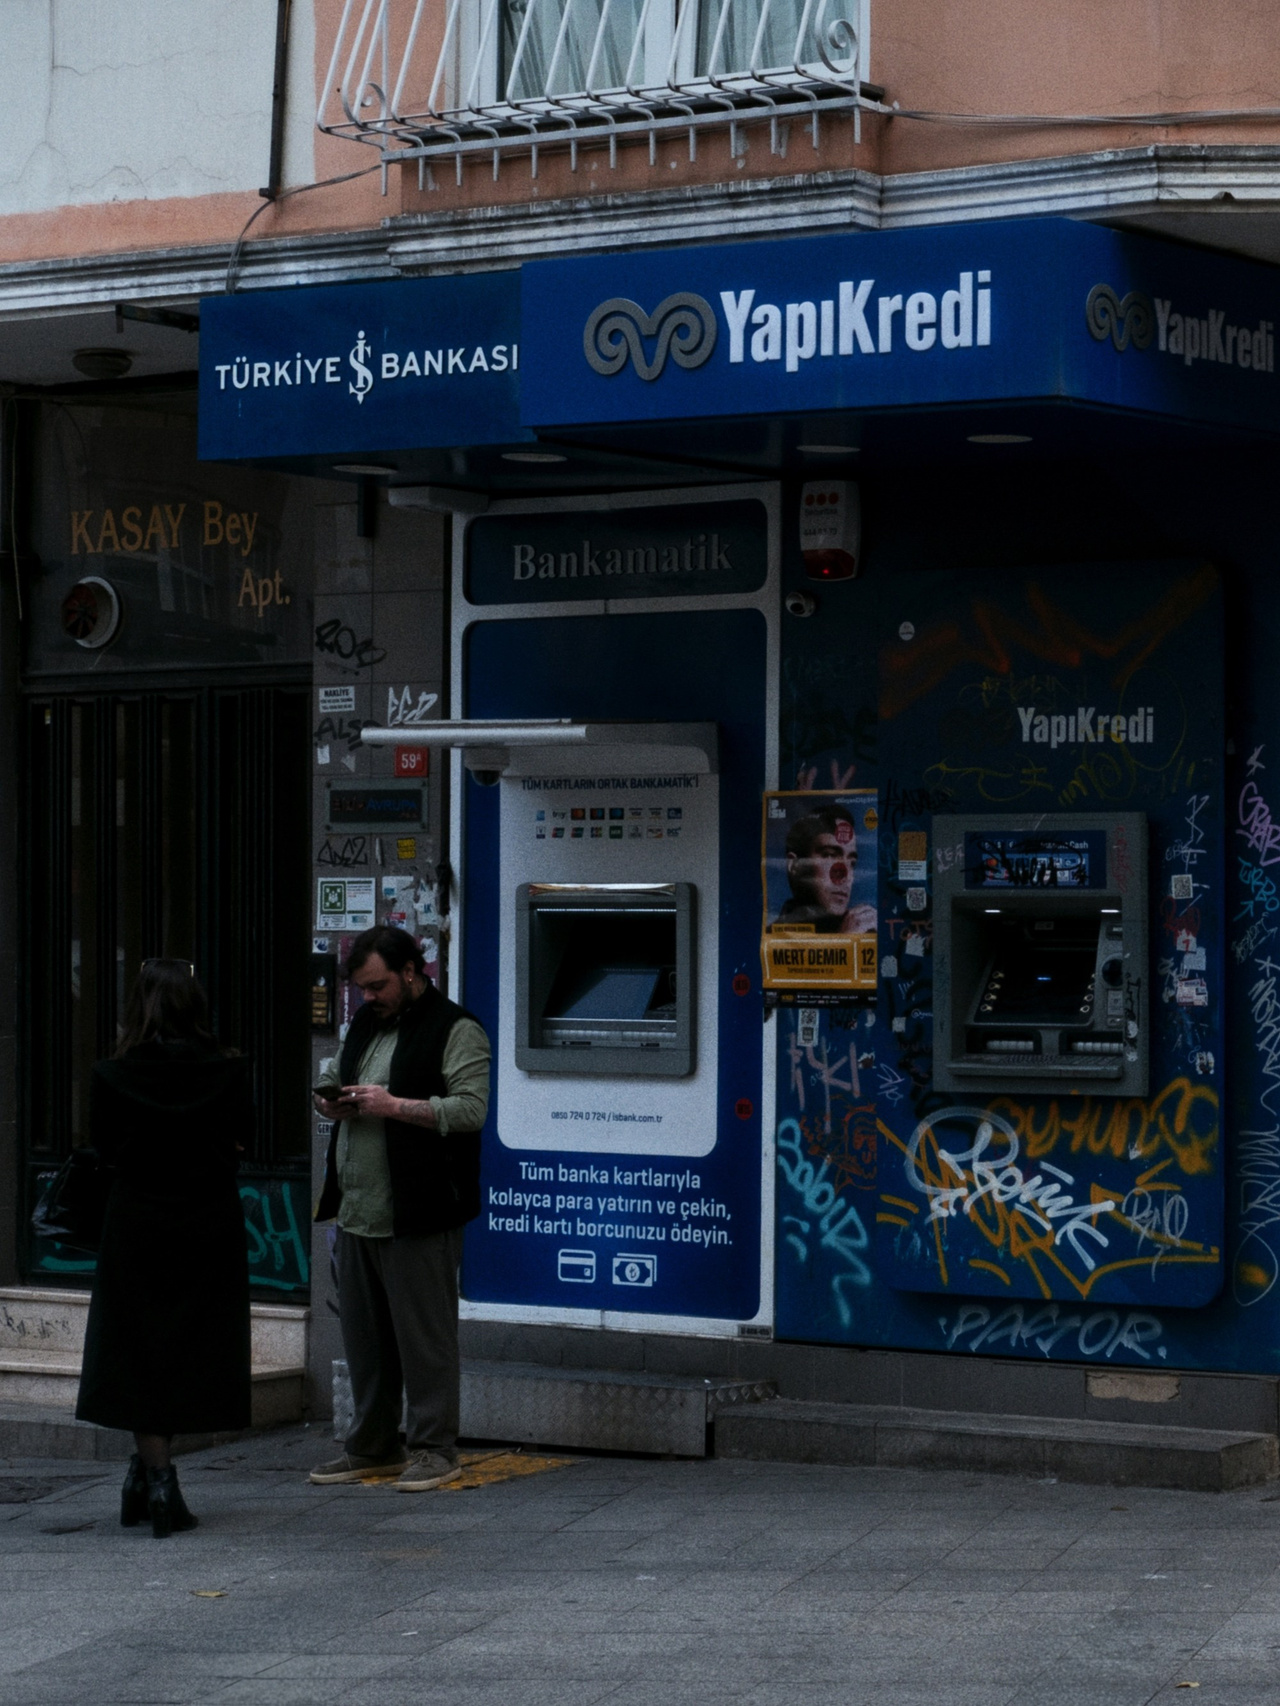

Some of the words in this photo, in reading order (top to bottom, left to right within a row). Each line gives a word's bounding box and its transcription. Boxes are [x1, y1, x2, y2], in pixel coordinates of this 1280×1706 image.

[720, 269, 991, 373] YapıKredi
[1154, 298, 1275, 373] YapıKredi
[214, 352, 341, 390] TÜRKİYE
[381, 344, 519, 379] BANKASI
[70, 503, 188, 556] KASAY
[203, 501, 258, 557] Bey
[512, 533, 735, 580] Bankamatik
[238, 567, 291, 618] Apt.
[1017, 707, 1154, 749] YapıKredi
[522, 776, 541, 790] TÜM
[543, 778, 595, 790] KARTLARIN
[597, 777, 628, 790] ORTAK
[773, 948, 805, 966] MERT
[808, 948, 847, 966] DEMİR
[861, 949, 875, 966] 12
[569, 1111, 584, 1120] 724
[585, 1112, 590, 1120] 0
[592, 1112, 606, 1121] 724
[519, 1161, 554, 1182] Tüm
[558, 1163, 609, 1184] banka
[613, 1166, 701, 1193] kartlarıyla
[489, 1186, 552, 1211] kolayca
[555, 1193, 593, 1213] para
[597, 1194, 652, 1215] yatırın
[657, 1199, 676, 1214] ve
[680, 1198, 732, 1221] çekin,
[488, 1212, 530, 1233] kredi
[534, 1215, 572, 1236] kartı
[576, 1217, 666, 1241] borcunuzu
[670, 1222, 733, 1248] ödeyin.
